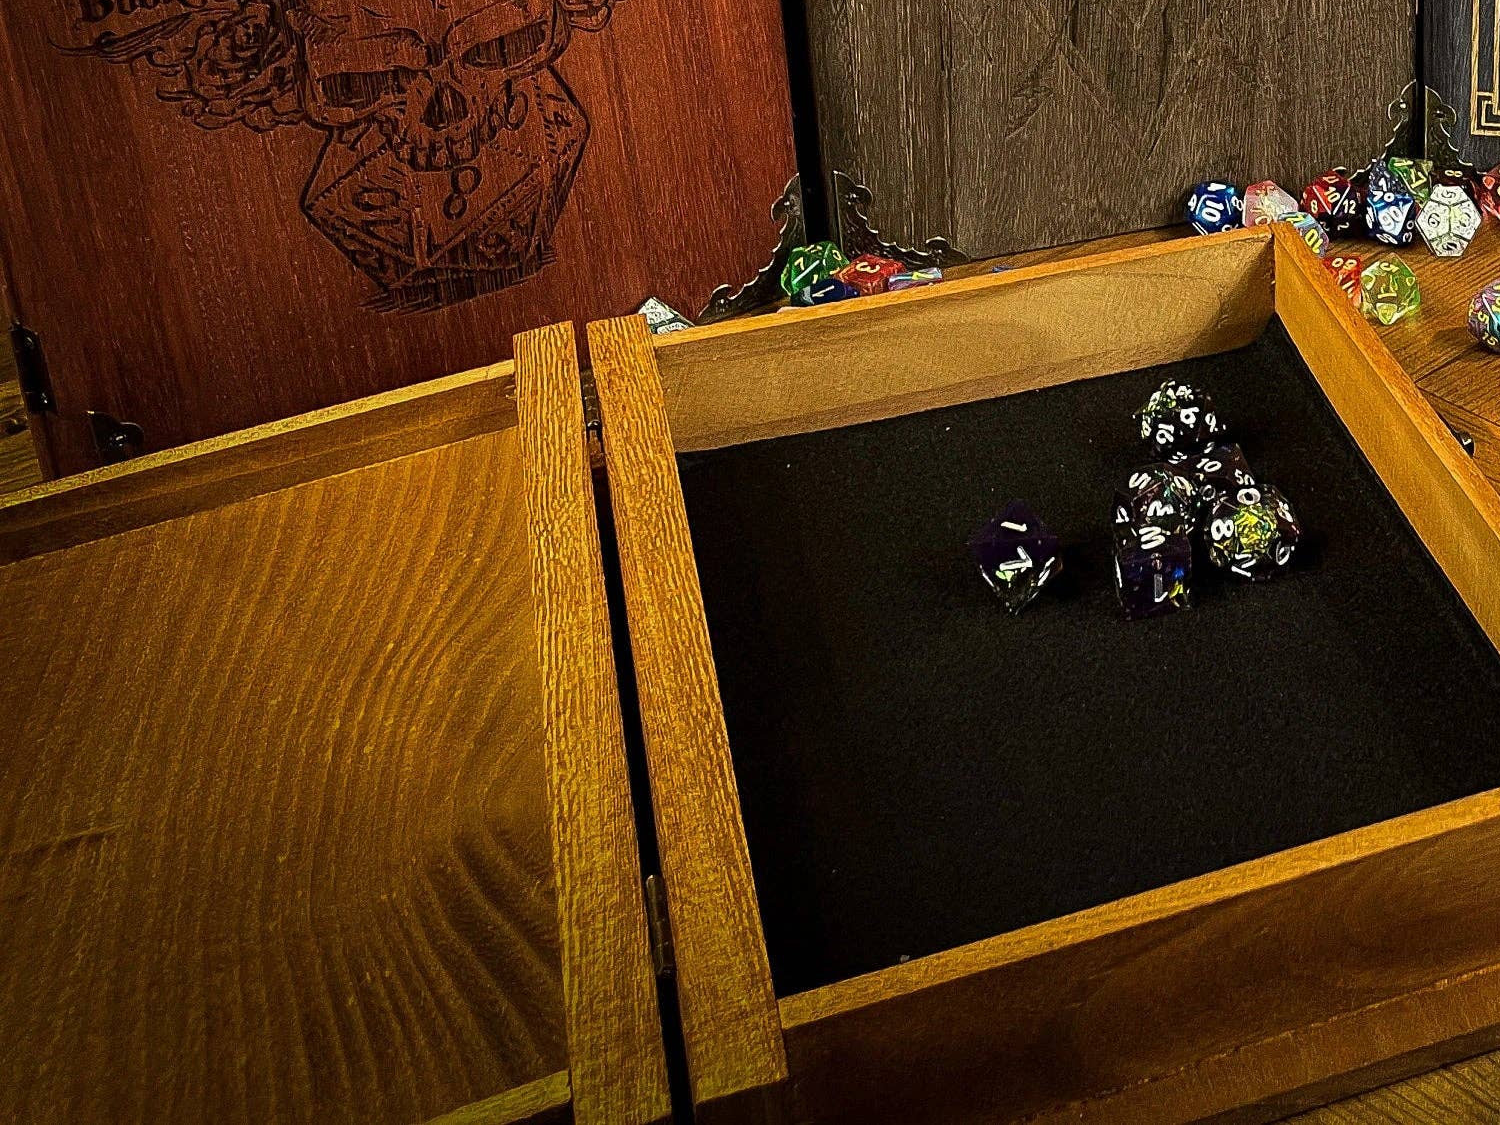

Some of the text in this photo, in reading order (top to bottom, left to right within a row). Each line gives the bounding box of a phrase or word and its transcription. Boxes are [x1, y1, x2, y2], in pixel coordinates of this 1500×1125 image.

[442, 164, 482, 221] 8
[1324, 186, 1341, 203] 10
[1201, 200, 1225, 223] 10
[1310, 199, 1319, 214] 8
[1342, 198, 1356, 215] 12
[1304, 228, 1324, 254] 10
[1196, 458, 1222, 473] 10
[1210, 518, 1235, 541] 8
